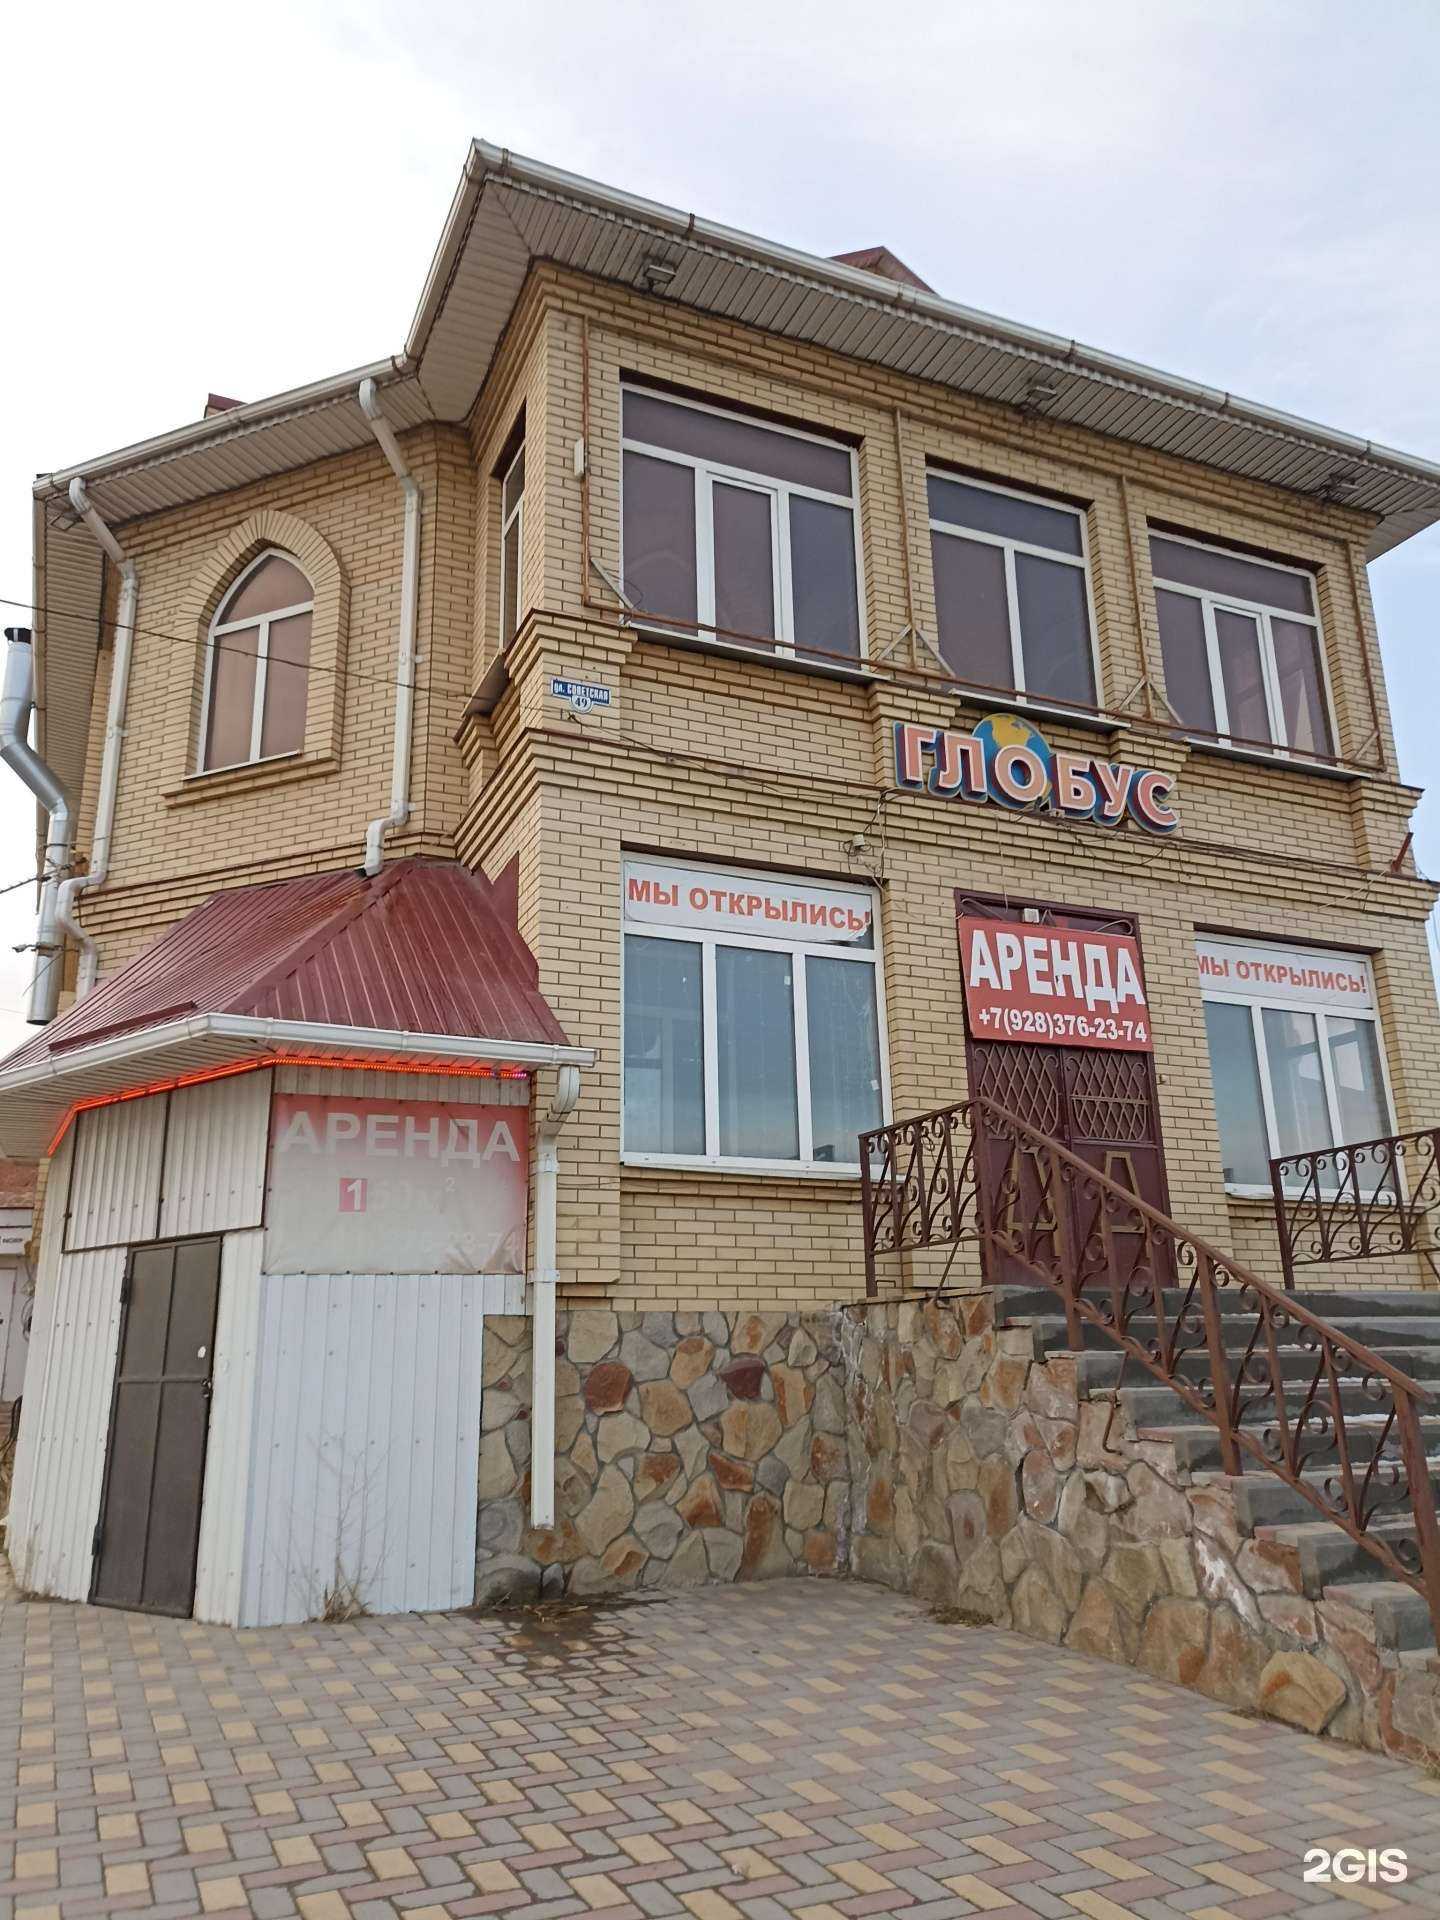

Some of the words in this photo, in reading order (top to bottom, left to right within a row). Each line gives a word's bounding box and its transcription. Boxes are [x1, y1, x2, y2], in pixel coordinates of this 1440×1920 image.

[567, 684, 608, 700] СОВЕТСКАЯ
[574, 697, 588, 708] 49
[894, 722, 1180, 832] ГЛОБУС
[628, 878, 679, 906] МЫ
[969, 929, 1146, 1014] АРЕНДА
[1236, 960, 1367, 993] ОТКРЫЛИСЬ!
[978, 1007, 1148, 1043] +7(928)376-23-74
[275, 1110, 521, 1169] АРЕНДА
